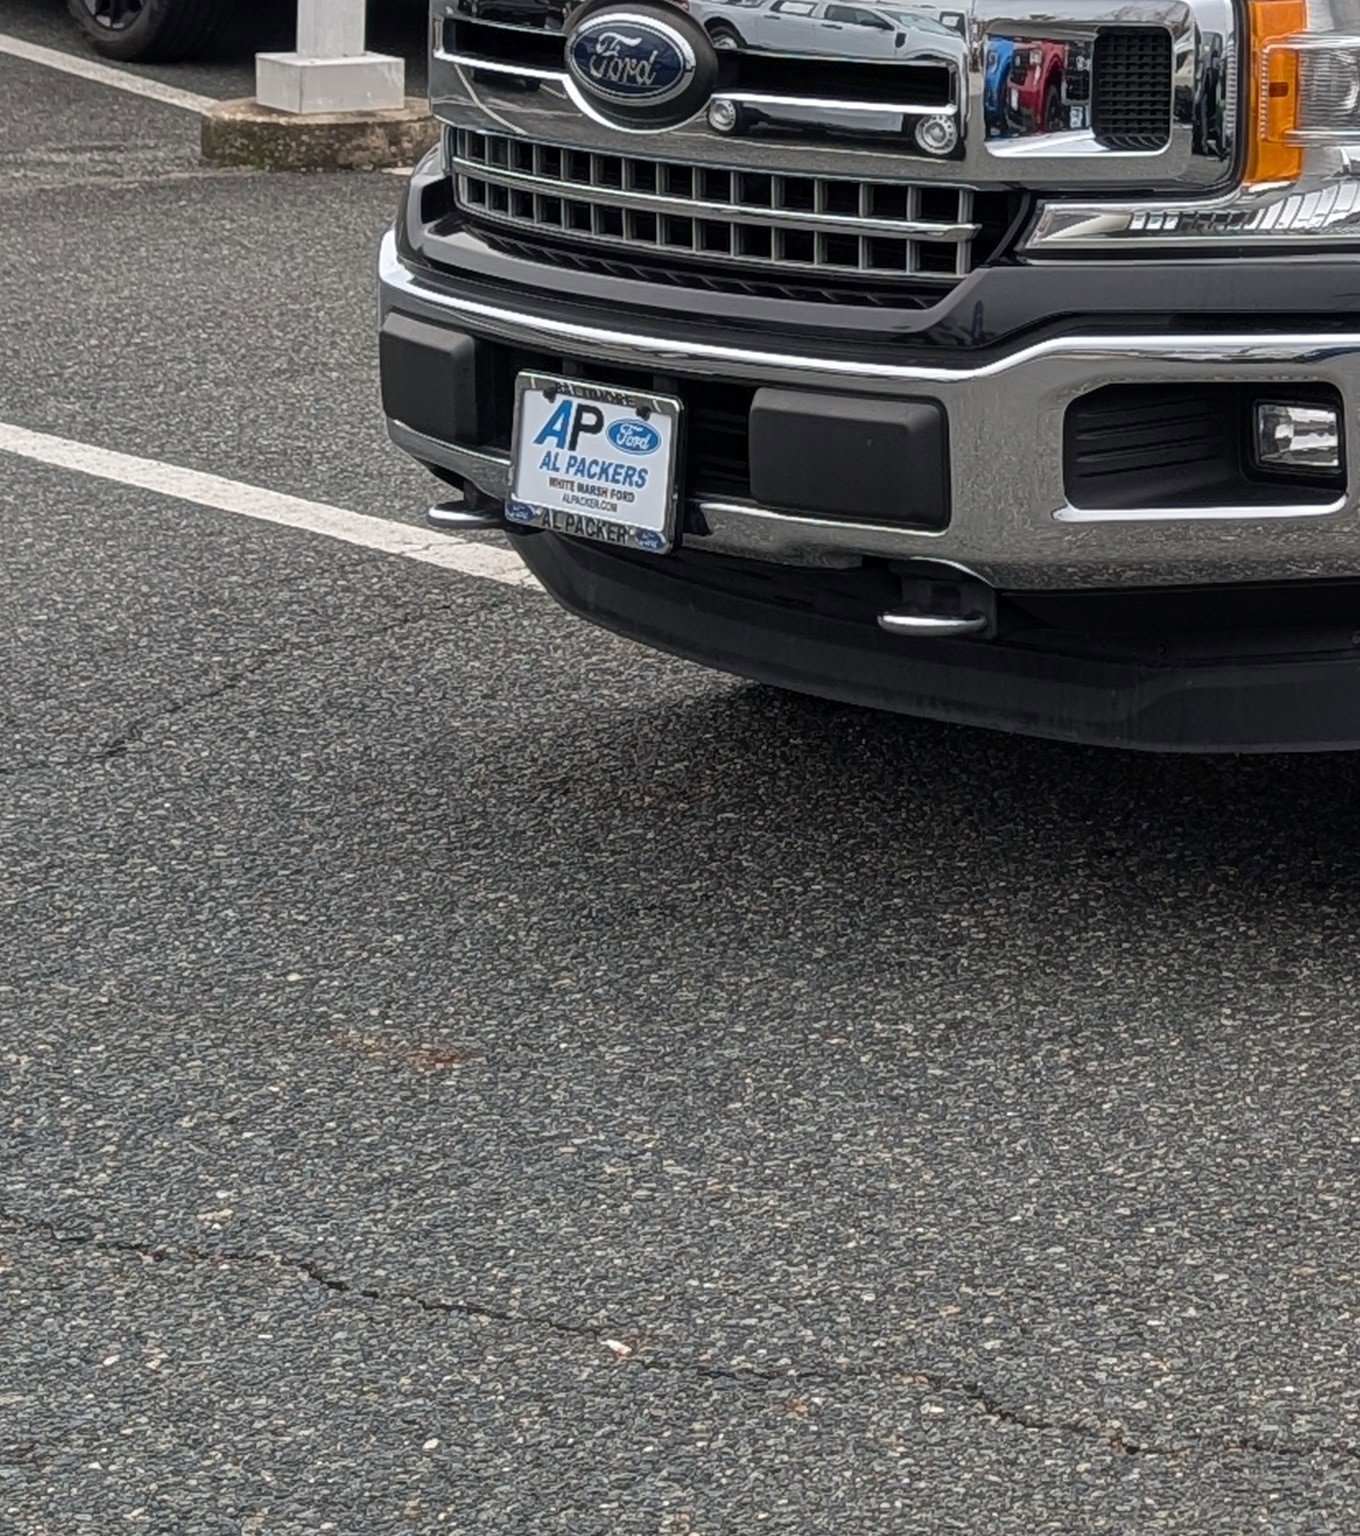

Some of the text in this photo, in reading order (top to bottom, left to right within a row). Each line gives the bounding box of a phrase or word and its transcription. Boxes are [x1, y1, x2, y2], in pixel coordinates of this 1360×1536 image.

[589, 31, 660, 85] Ford
[533, 399, 652, 452] AP Ford
[539, 450, 649, 489] AL PACKERS
[548, 477, 636, 503] WHITE MARSH FORD
[541, 508, 561, 529] AL
[565, 515, 627, 544] PACKER
